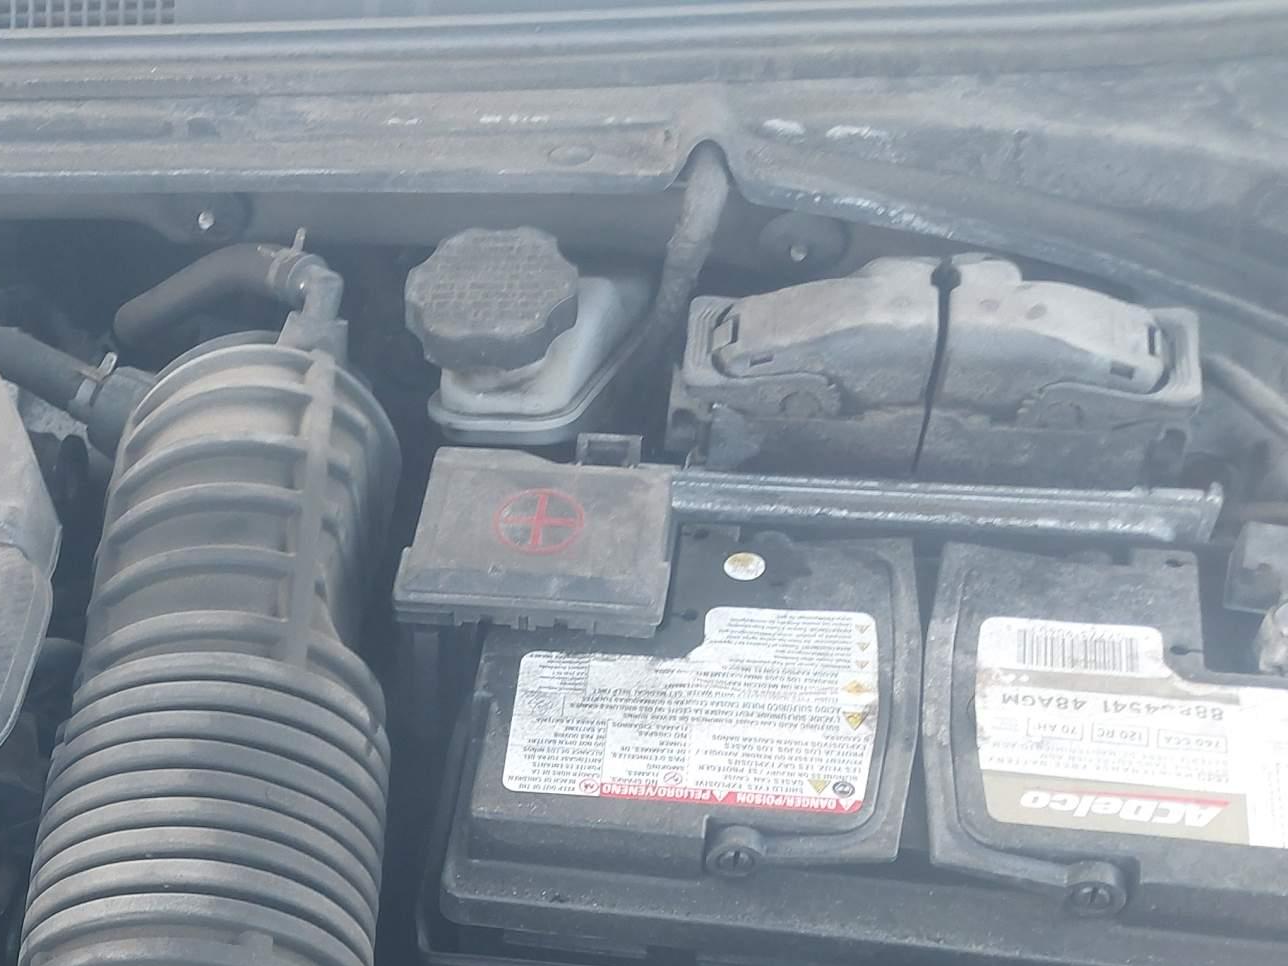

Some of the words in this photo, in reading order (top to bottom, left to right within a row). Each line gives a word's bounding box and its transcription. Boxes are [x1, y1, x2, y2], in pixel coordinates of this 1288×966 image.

[1000, 691, 1088, 711] 48AGM
[735, 792, 837, 810] DANGER/POISON
[1018, 789, 1222, 829] ACDelco
